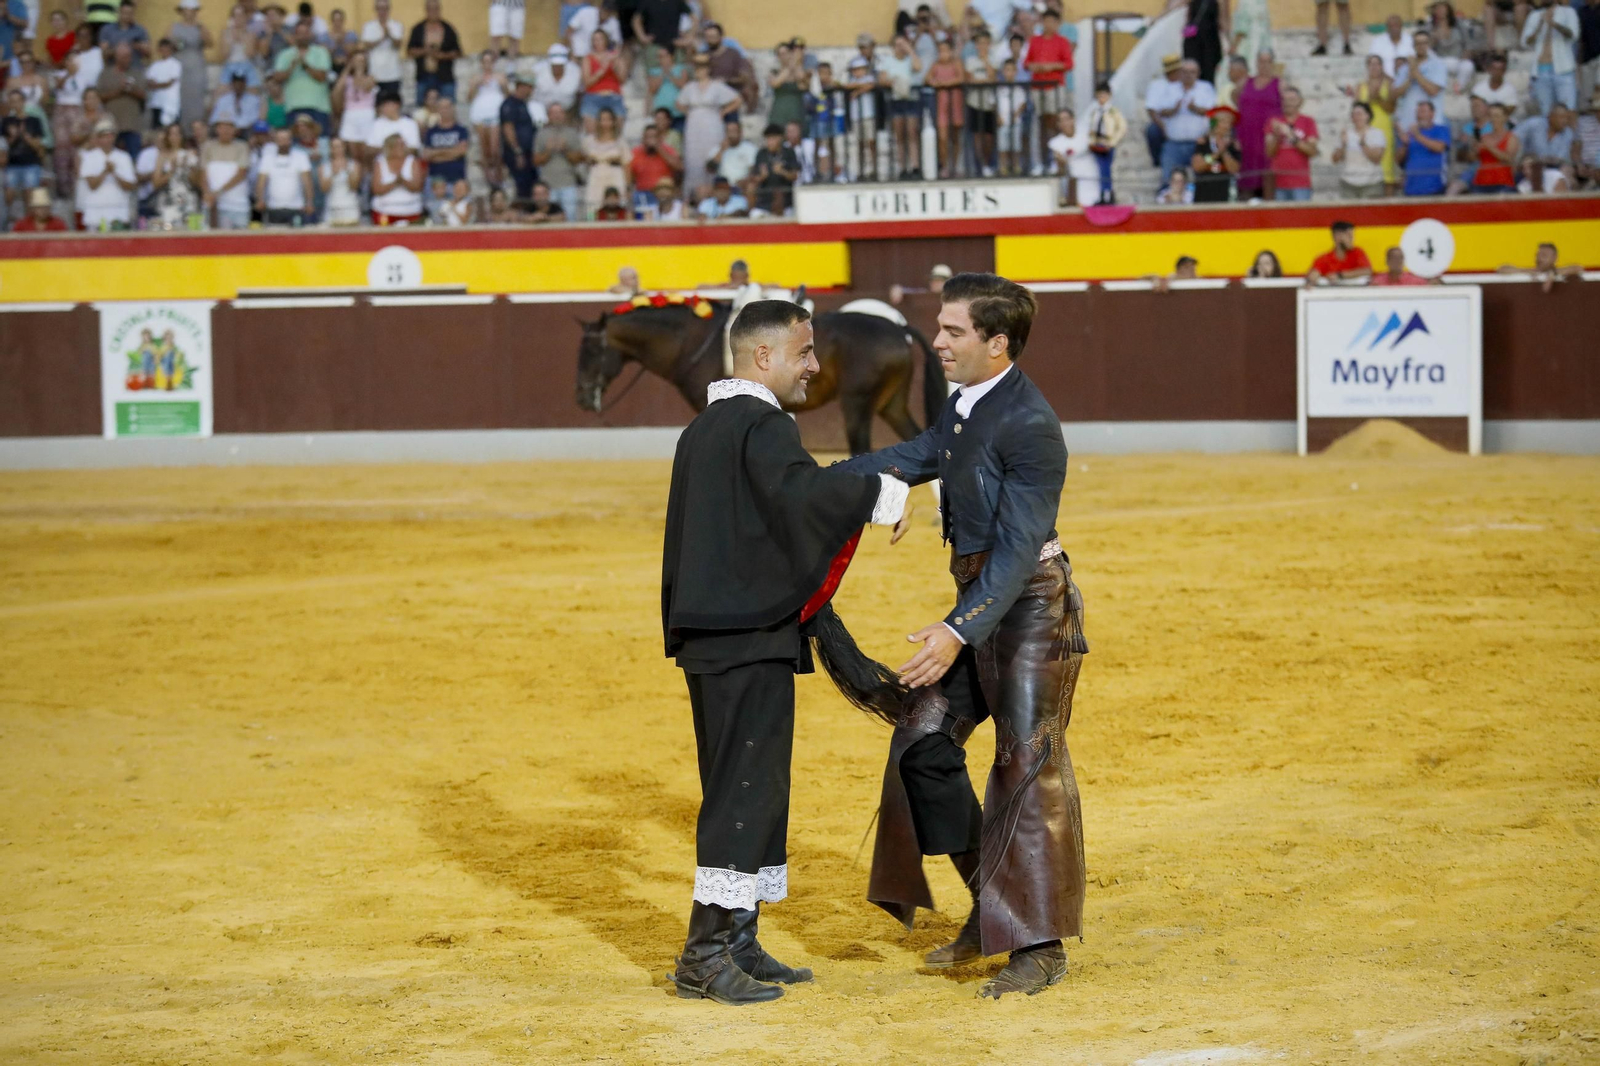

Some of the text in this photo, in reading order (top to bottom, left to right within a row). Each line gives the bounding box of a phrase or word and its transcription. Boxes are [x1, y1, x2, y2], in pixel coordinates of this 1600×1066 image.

[850, 189, 1000, 216] TORILES
[1418, 237, 1435, 261] 4
[1331, 357, 1445, 390] Mayfra
